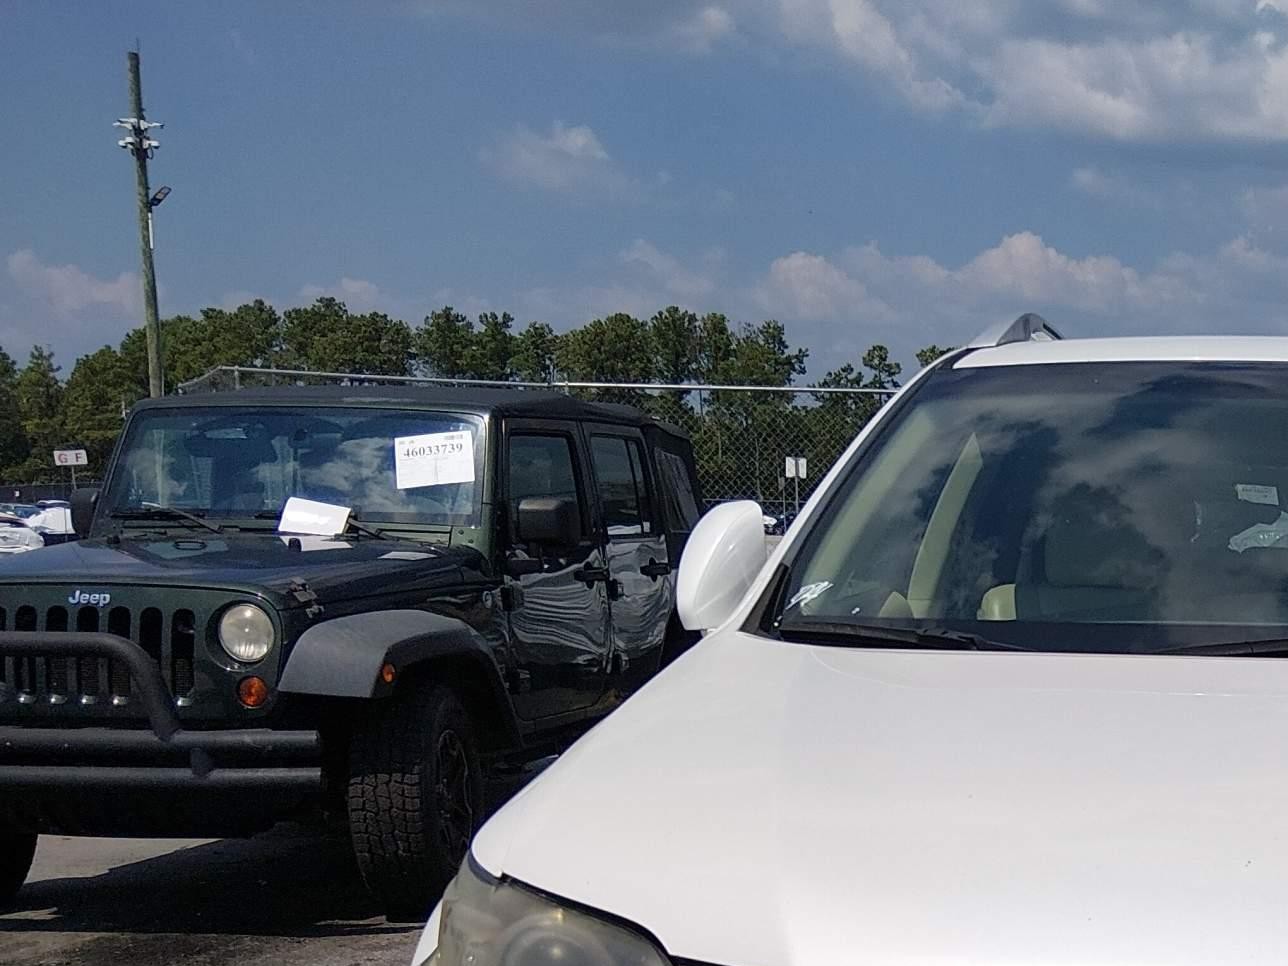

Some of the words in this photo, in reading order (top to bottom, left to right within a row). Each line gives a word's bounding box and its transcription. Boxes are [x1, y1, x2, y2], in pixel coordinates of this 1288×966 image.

[403, 443, 463, 457] 46033739
[58, 453, 68, 463] G
[75, 452, 82, 462] F
[68, 590, 110, 606] Jeep
